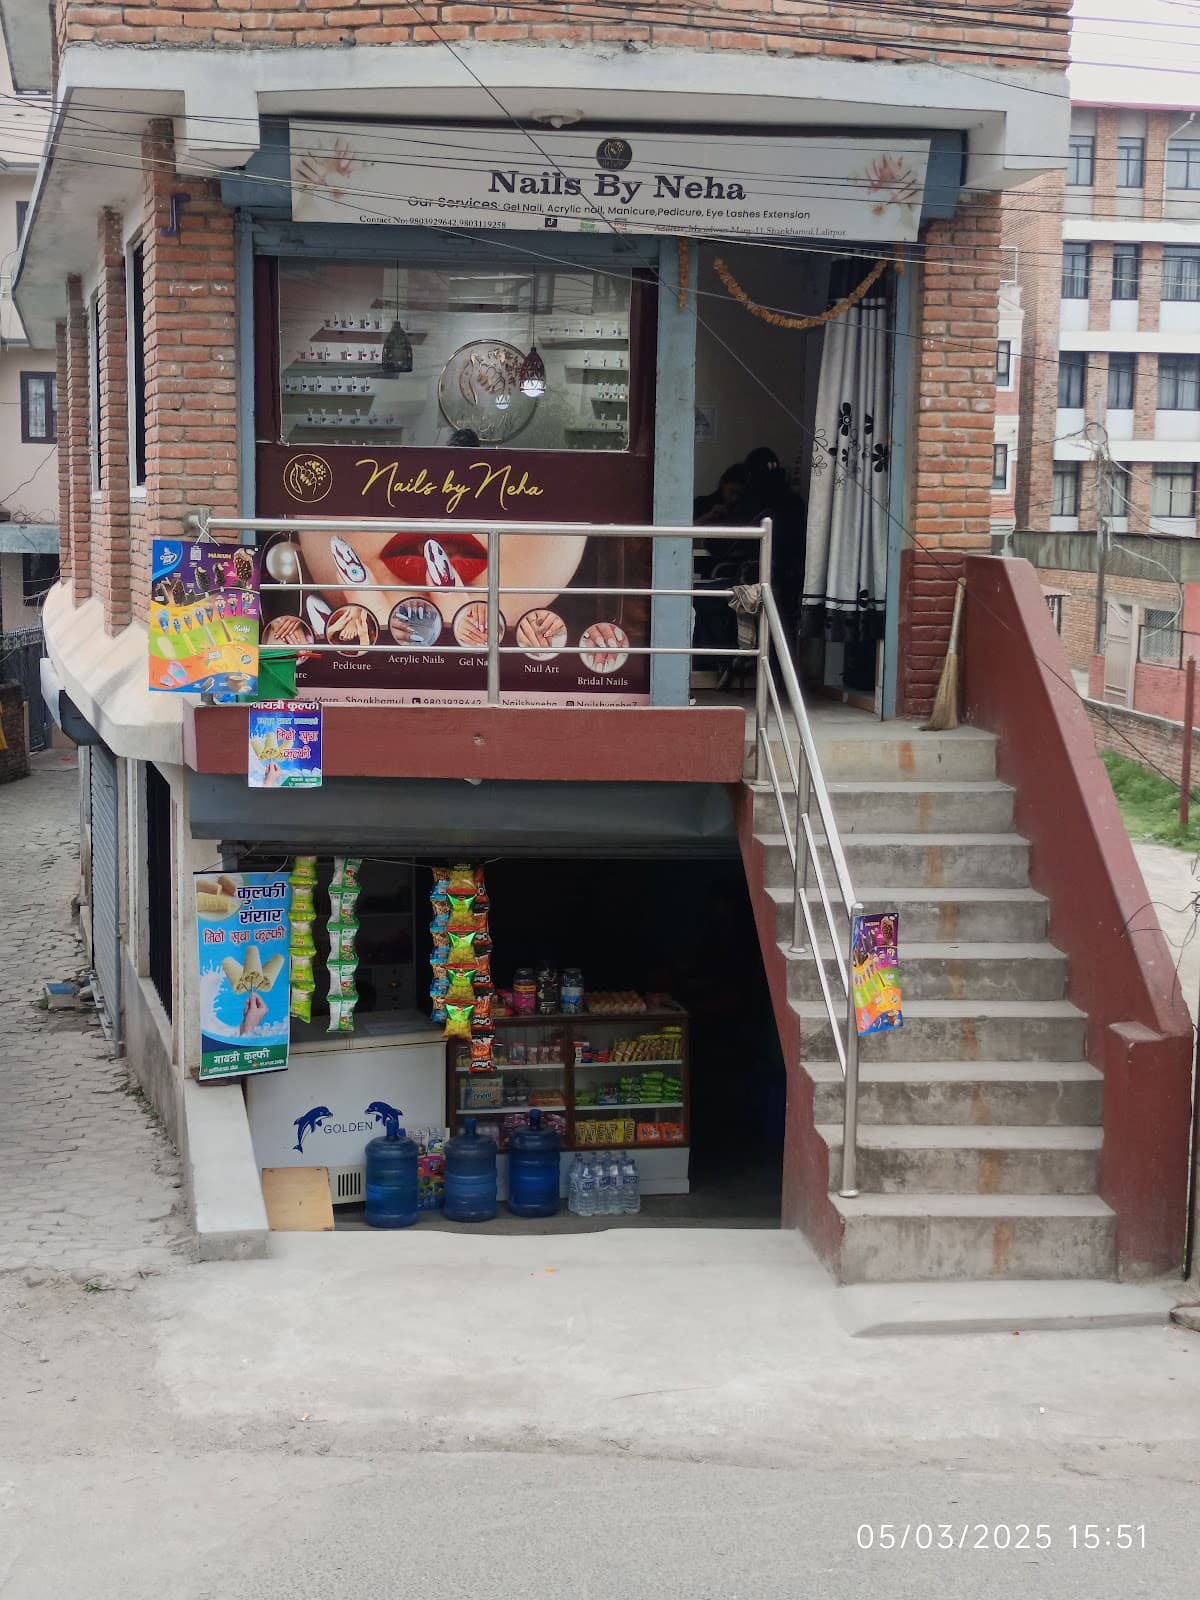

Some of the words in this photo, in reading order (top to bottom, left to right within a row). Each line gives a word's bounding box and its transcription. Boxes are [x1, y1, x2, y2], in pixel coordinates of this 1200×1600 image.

[488, 170, 582, 196] Nails
[594, 173, 643, 204] By
[653, 175, 747, 200] Neha
[408, 196, 433, 207] Our
[503, 202, 520, 212] Gel
[523, 203, 544, 214] Nail,
[547, 204, 581, 217] Acrylic
[706, 209, 724, 220] Eye
[726, 209, 761, 219] Lashes
[763, 210, 811, 220] Extension
[359, 215, 391, 224] Contact
[355, 458, 437, 508] Nails
[442, 470, 472, 514] by
[469, 461, 544, 511] Neha
[333, 661, 372, 671] Pedicure
[388, 655, 420, 666] Acrylic
[422, 655, 445, 665] Nails
[458, 657, 474, 667] Gel
[524, 664, 543, 674] Nail
[545, 664, 560, 674] Art
[577, 676, 604, 687] Bridal
[606, 677, 628, 687] Nails
[237, 882, 286, 905] कुल्फी
[239, 907, 284, 924] संसार
[213, 1050, 241, 1065] गायत्री
[243, 1047, 271, 1064] कुल्फी
[323, 1121, 373, 1135] GOLDEN
